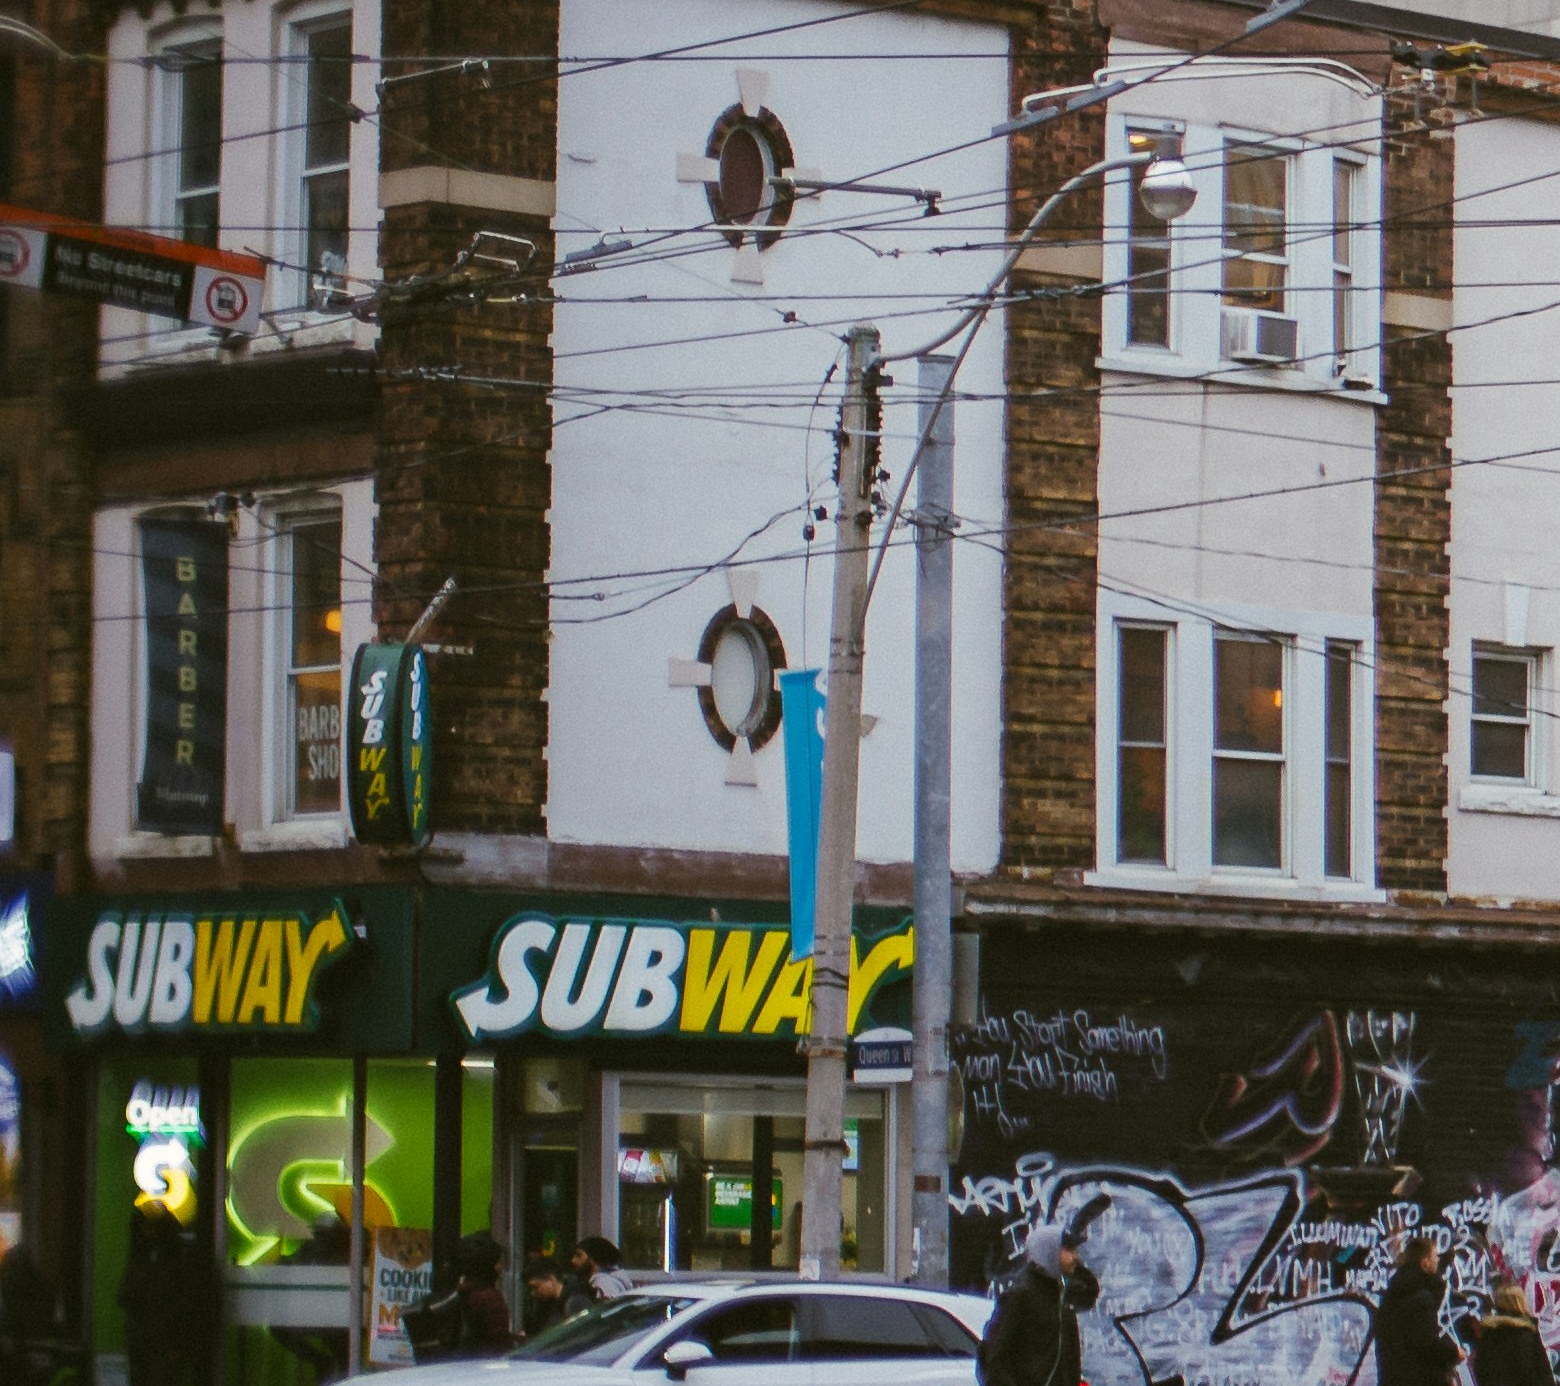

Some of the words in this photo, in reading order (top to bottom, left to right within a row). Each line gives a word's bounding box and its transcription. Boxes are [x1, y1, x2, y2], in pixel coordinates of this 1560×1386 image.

[86, 251, 183, 288] Streetcars
[175, 556, 198, 765] BARBER
[358, 669, 391, 821] SUBWAY
[409, 651, 424, 830] SUBWAY
[66, 910, 347, 1031] SUBWAY
[126, 1097, 200, 1128] Open
[858, 1043, 891, 1067] Queen
